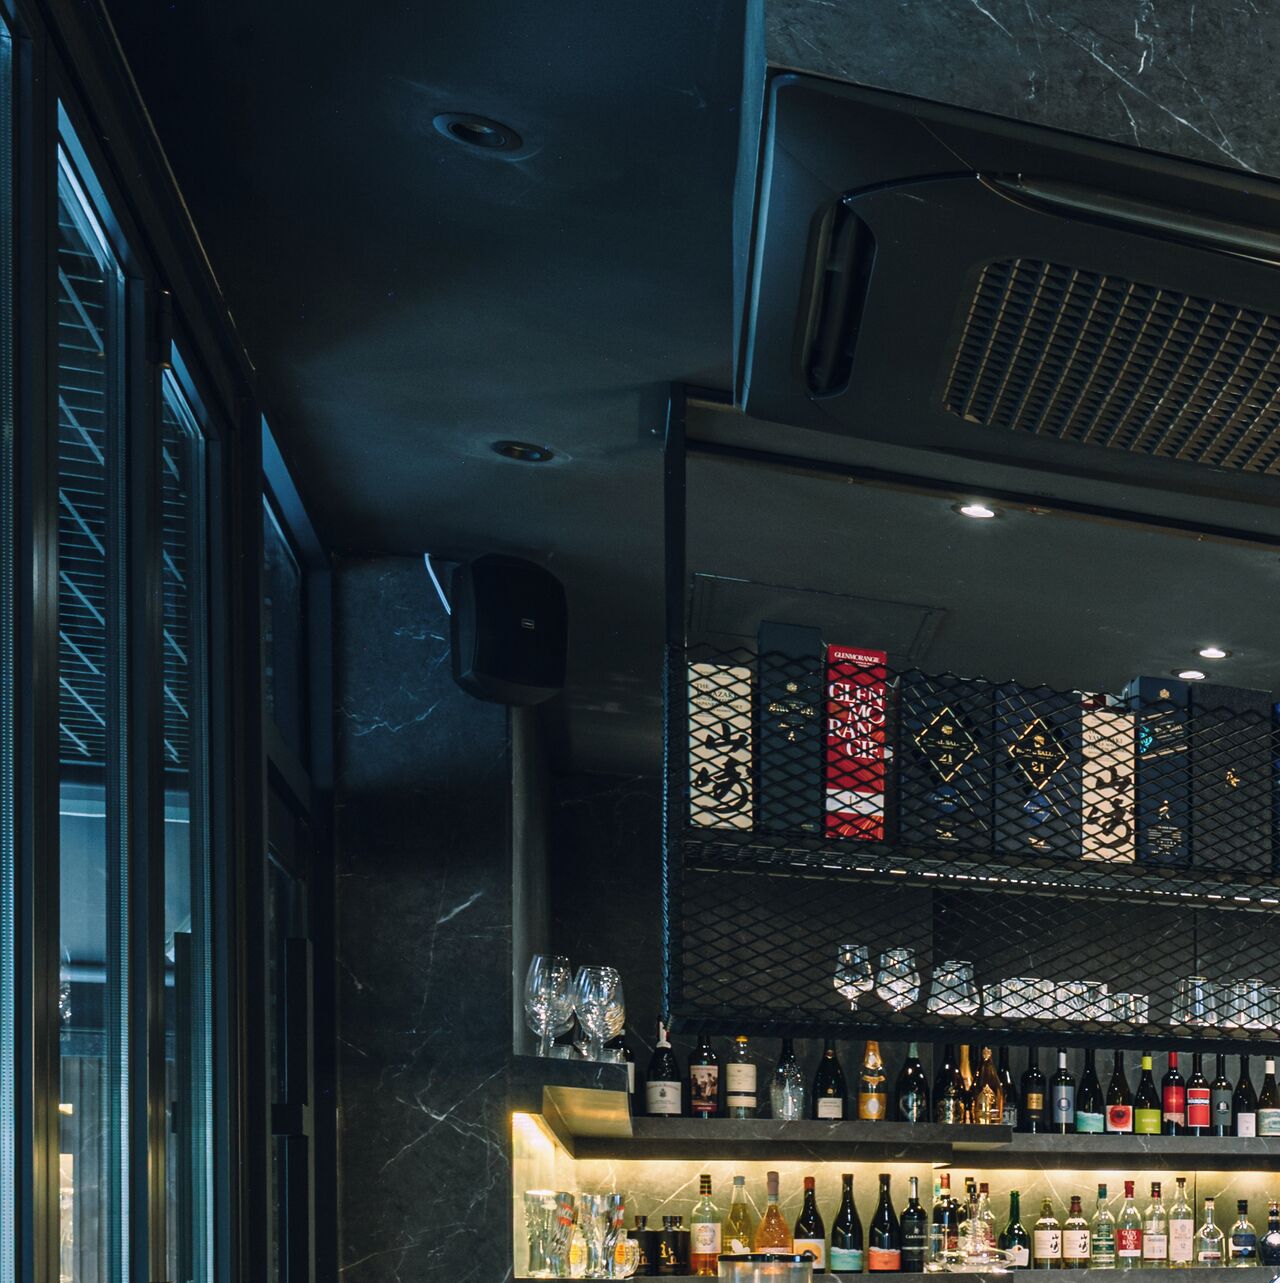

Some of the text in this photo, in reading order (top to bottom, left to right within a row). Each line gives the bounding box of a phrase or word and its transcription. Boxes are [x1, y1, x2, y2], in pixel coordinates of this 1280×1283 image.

[829, 682, 883, 706] GLEN
[848, 702, 885, 724] MO
[828, 718, 872, 739] RAN
[1031, 761, 1045, 774] 21
